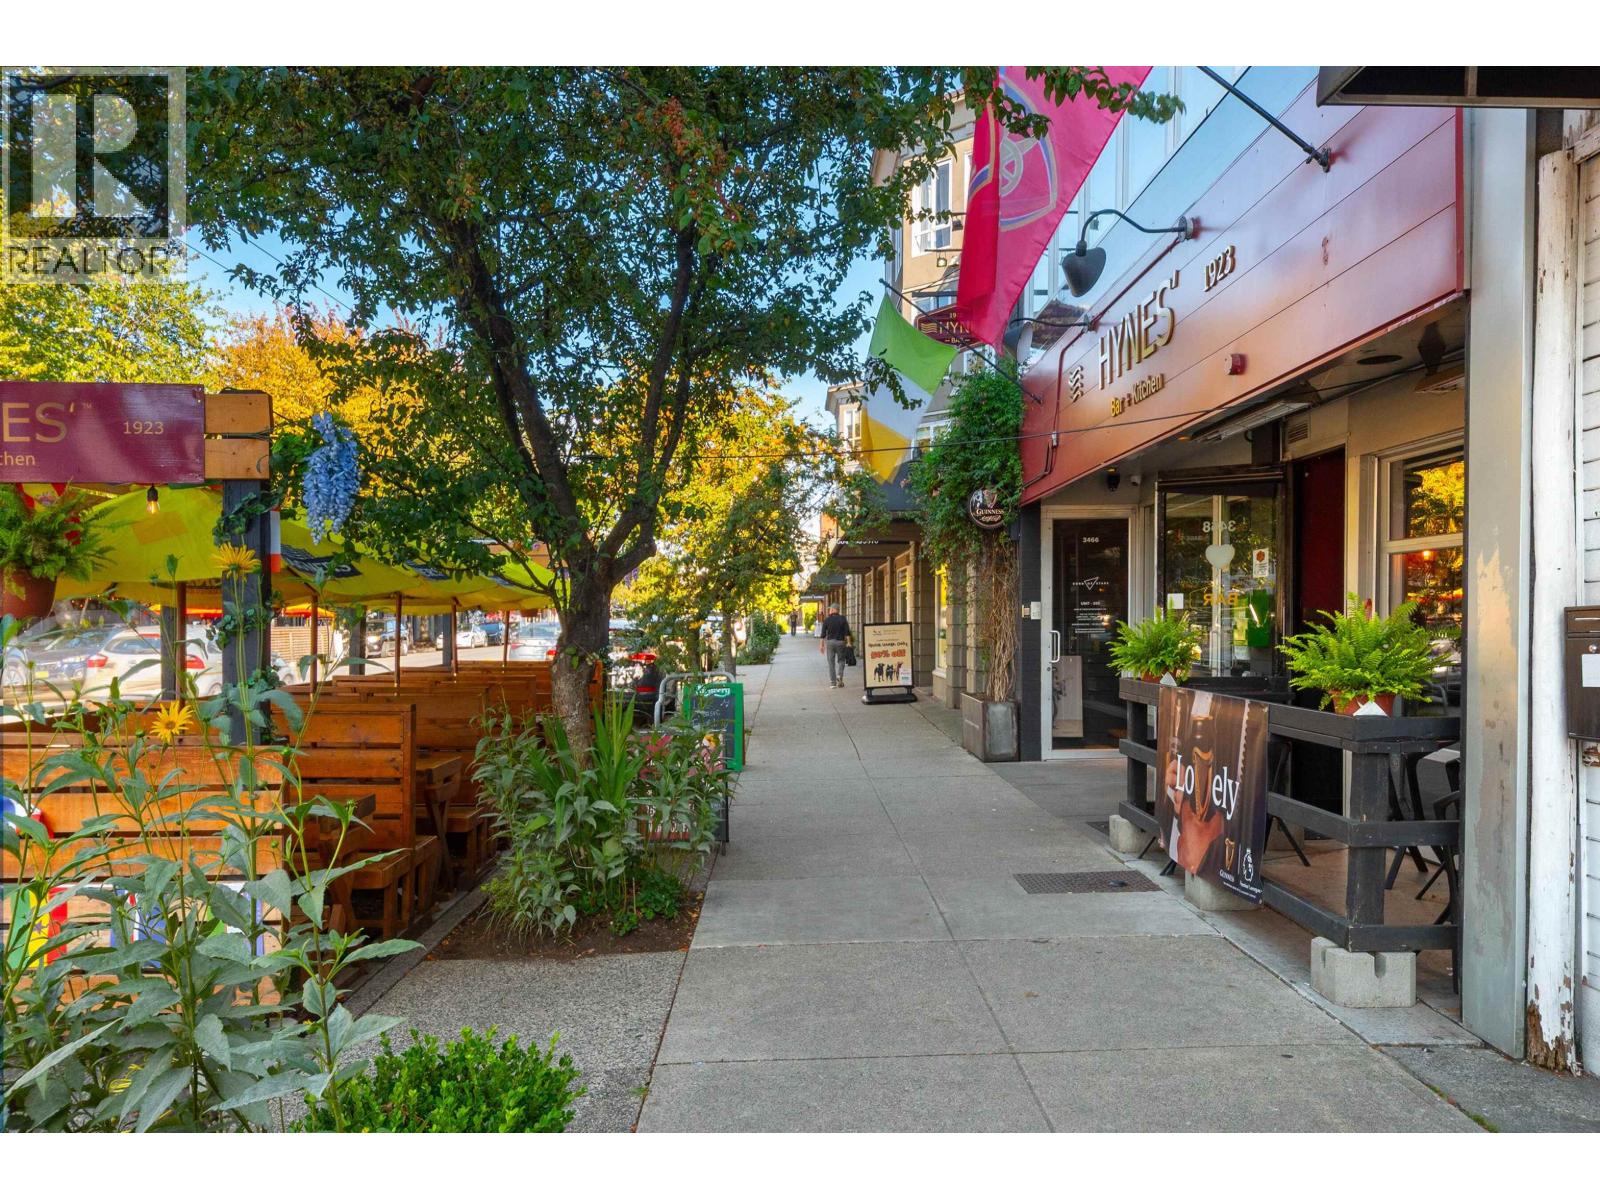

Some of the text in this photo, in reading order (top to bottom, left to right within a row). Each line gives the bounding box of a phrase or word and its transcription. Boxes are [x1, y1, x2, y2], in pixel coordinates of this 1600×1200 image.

[1203, 245, 1236, 292] 1923
[1111, 397, 1126, 417] Bar
[1132, 373, 1165, 404] Kitchen
[123, 421, 164, 435] 1923
